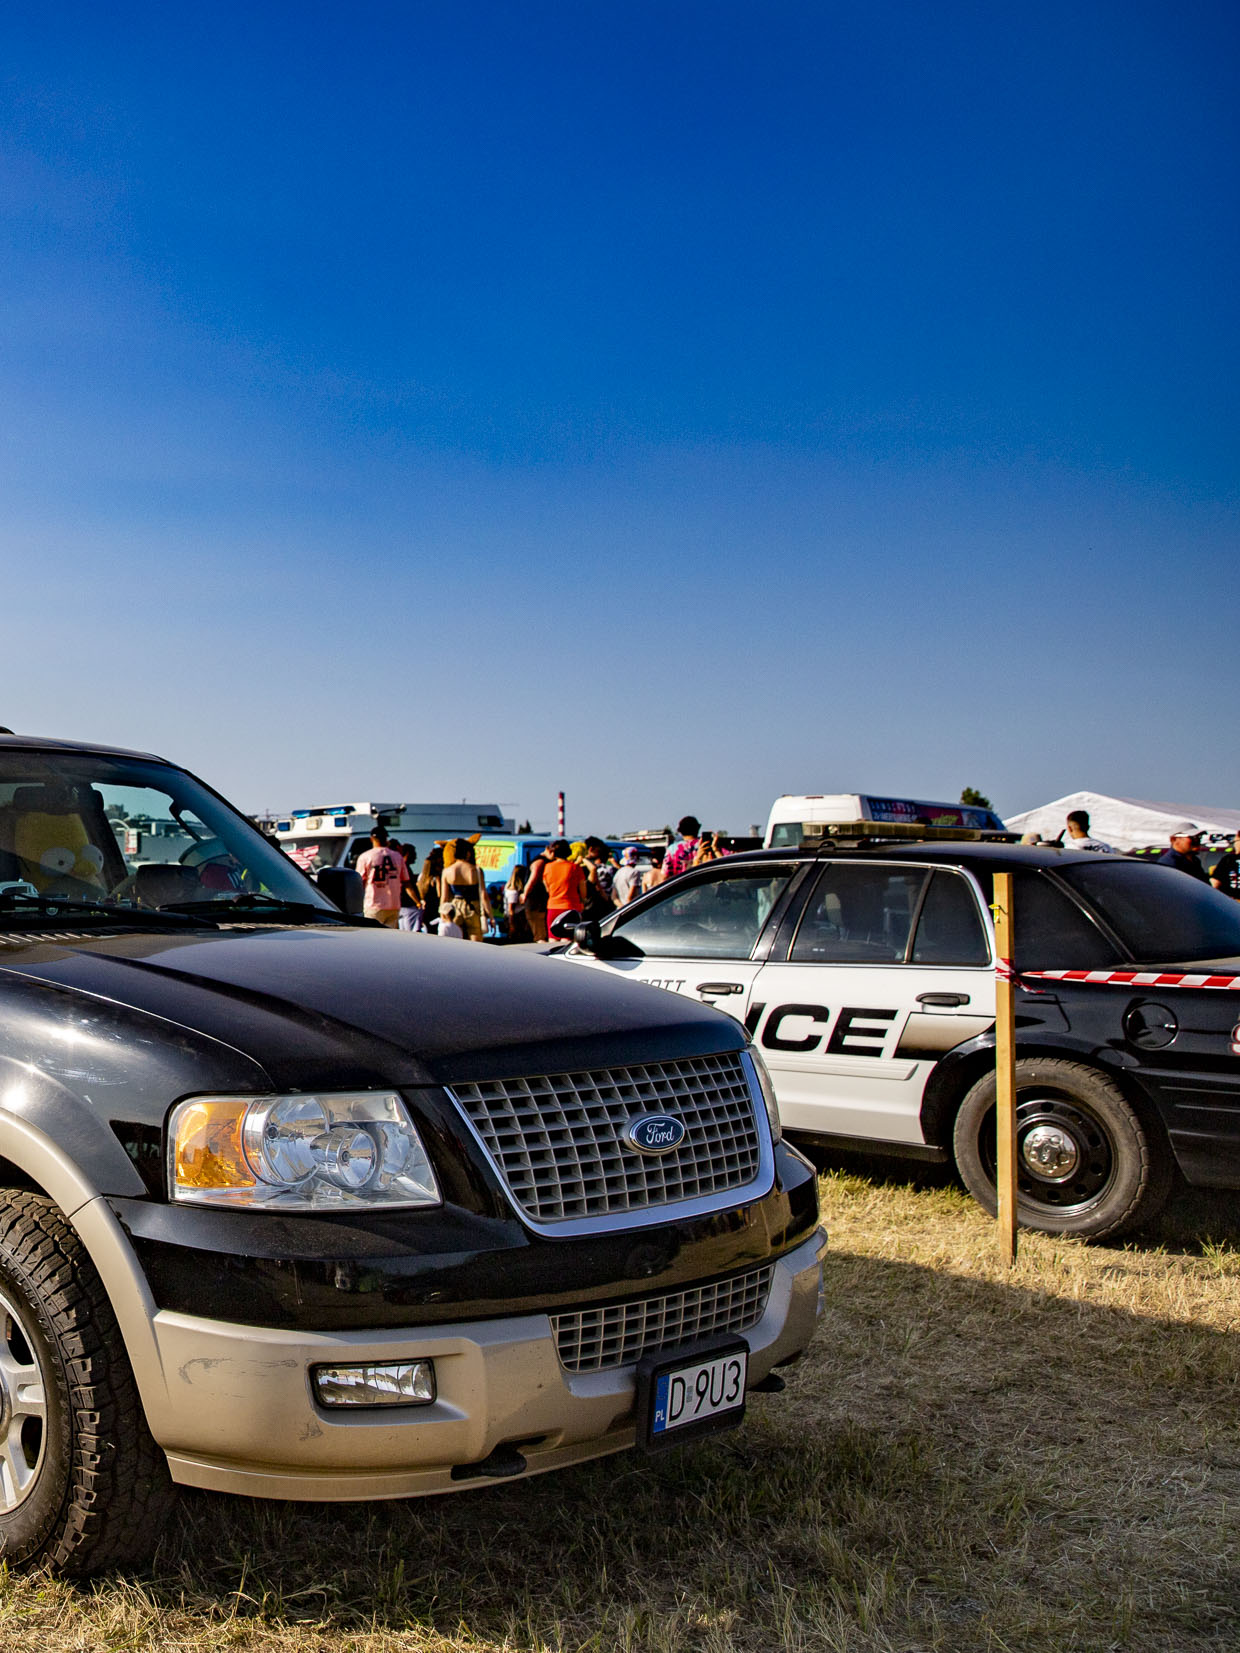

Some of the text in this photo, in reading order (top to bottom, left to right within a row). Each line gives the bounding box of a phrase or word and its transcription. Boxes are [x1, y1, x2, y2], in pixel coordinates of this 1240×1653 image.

[720, 1002, 899, 1058] ICE
[646, 1122, 675, 1144] Ford
[655, 1360, 742, 1423] PL D 9U3
